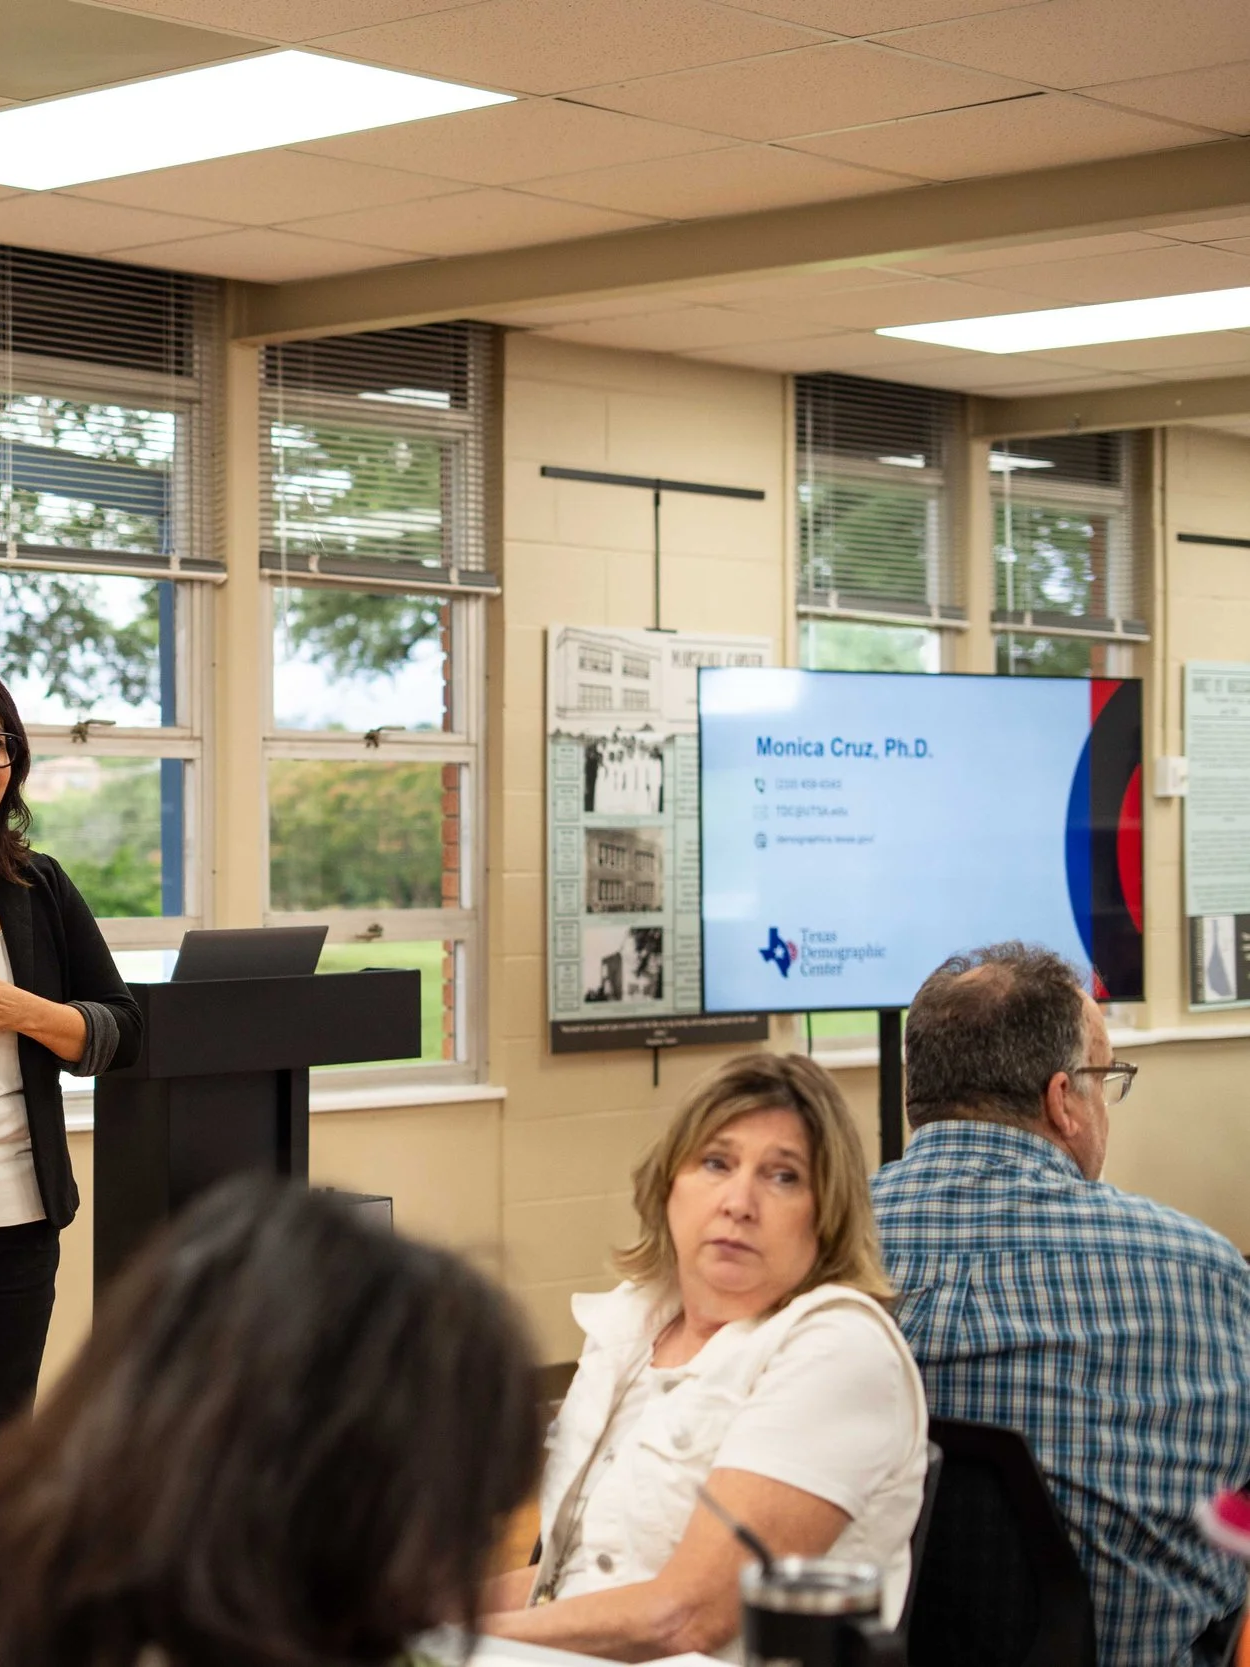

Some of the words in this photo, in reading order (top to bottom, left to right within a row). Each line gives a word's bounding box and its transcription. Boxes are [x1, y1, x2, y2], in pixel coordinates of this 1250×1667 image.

[756, 736, 824, 757] Monica
[830, 737, 879, 760] Cruz,
[884, 737, 934, 758] Ph.D.
[800, 927, 837, 942] Texas
[800, 942, 886, 962] Demographic
[799, 961, 843, 978] Center
